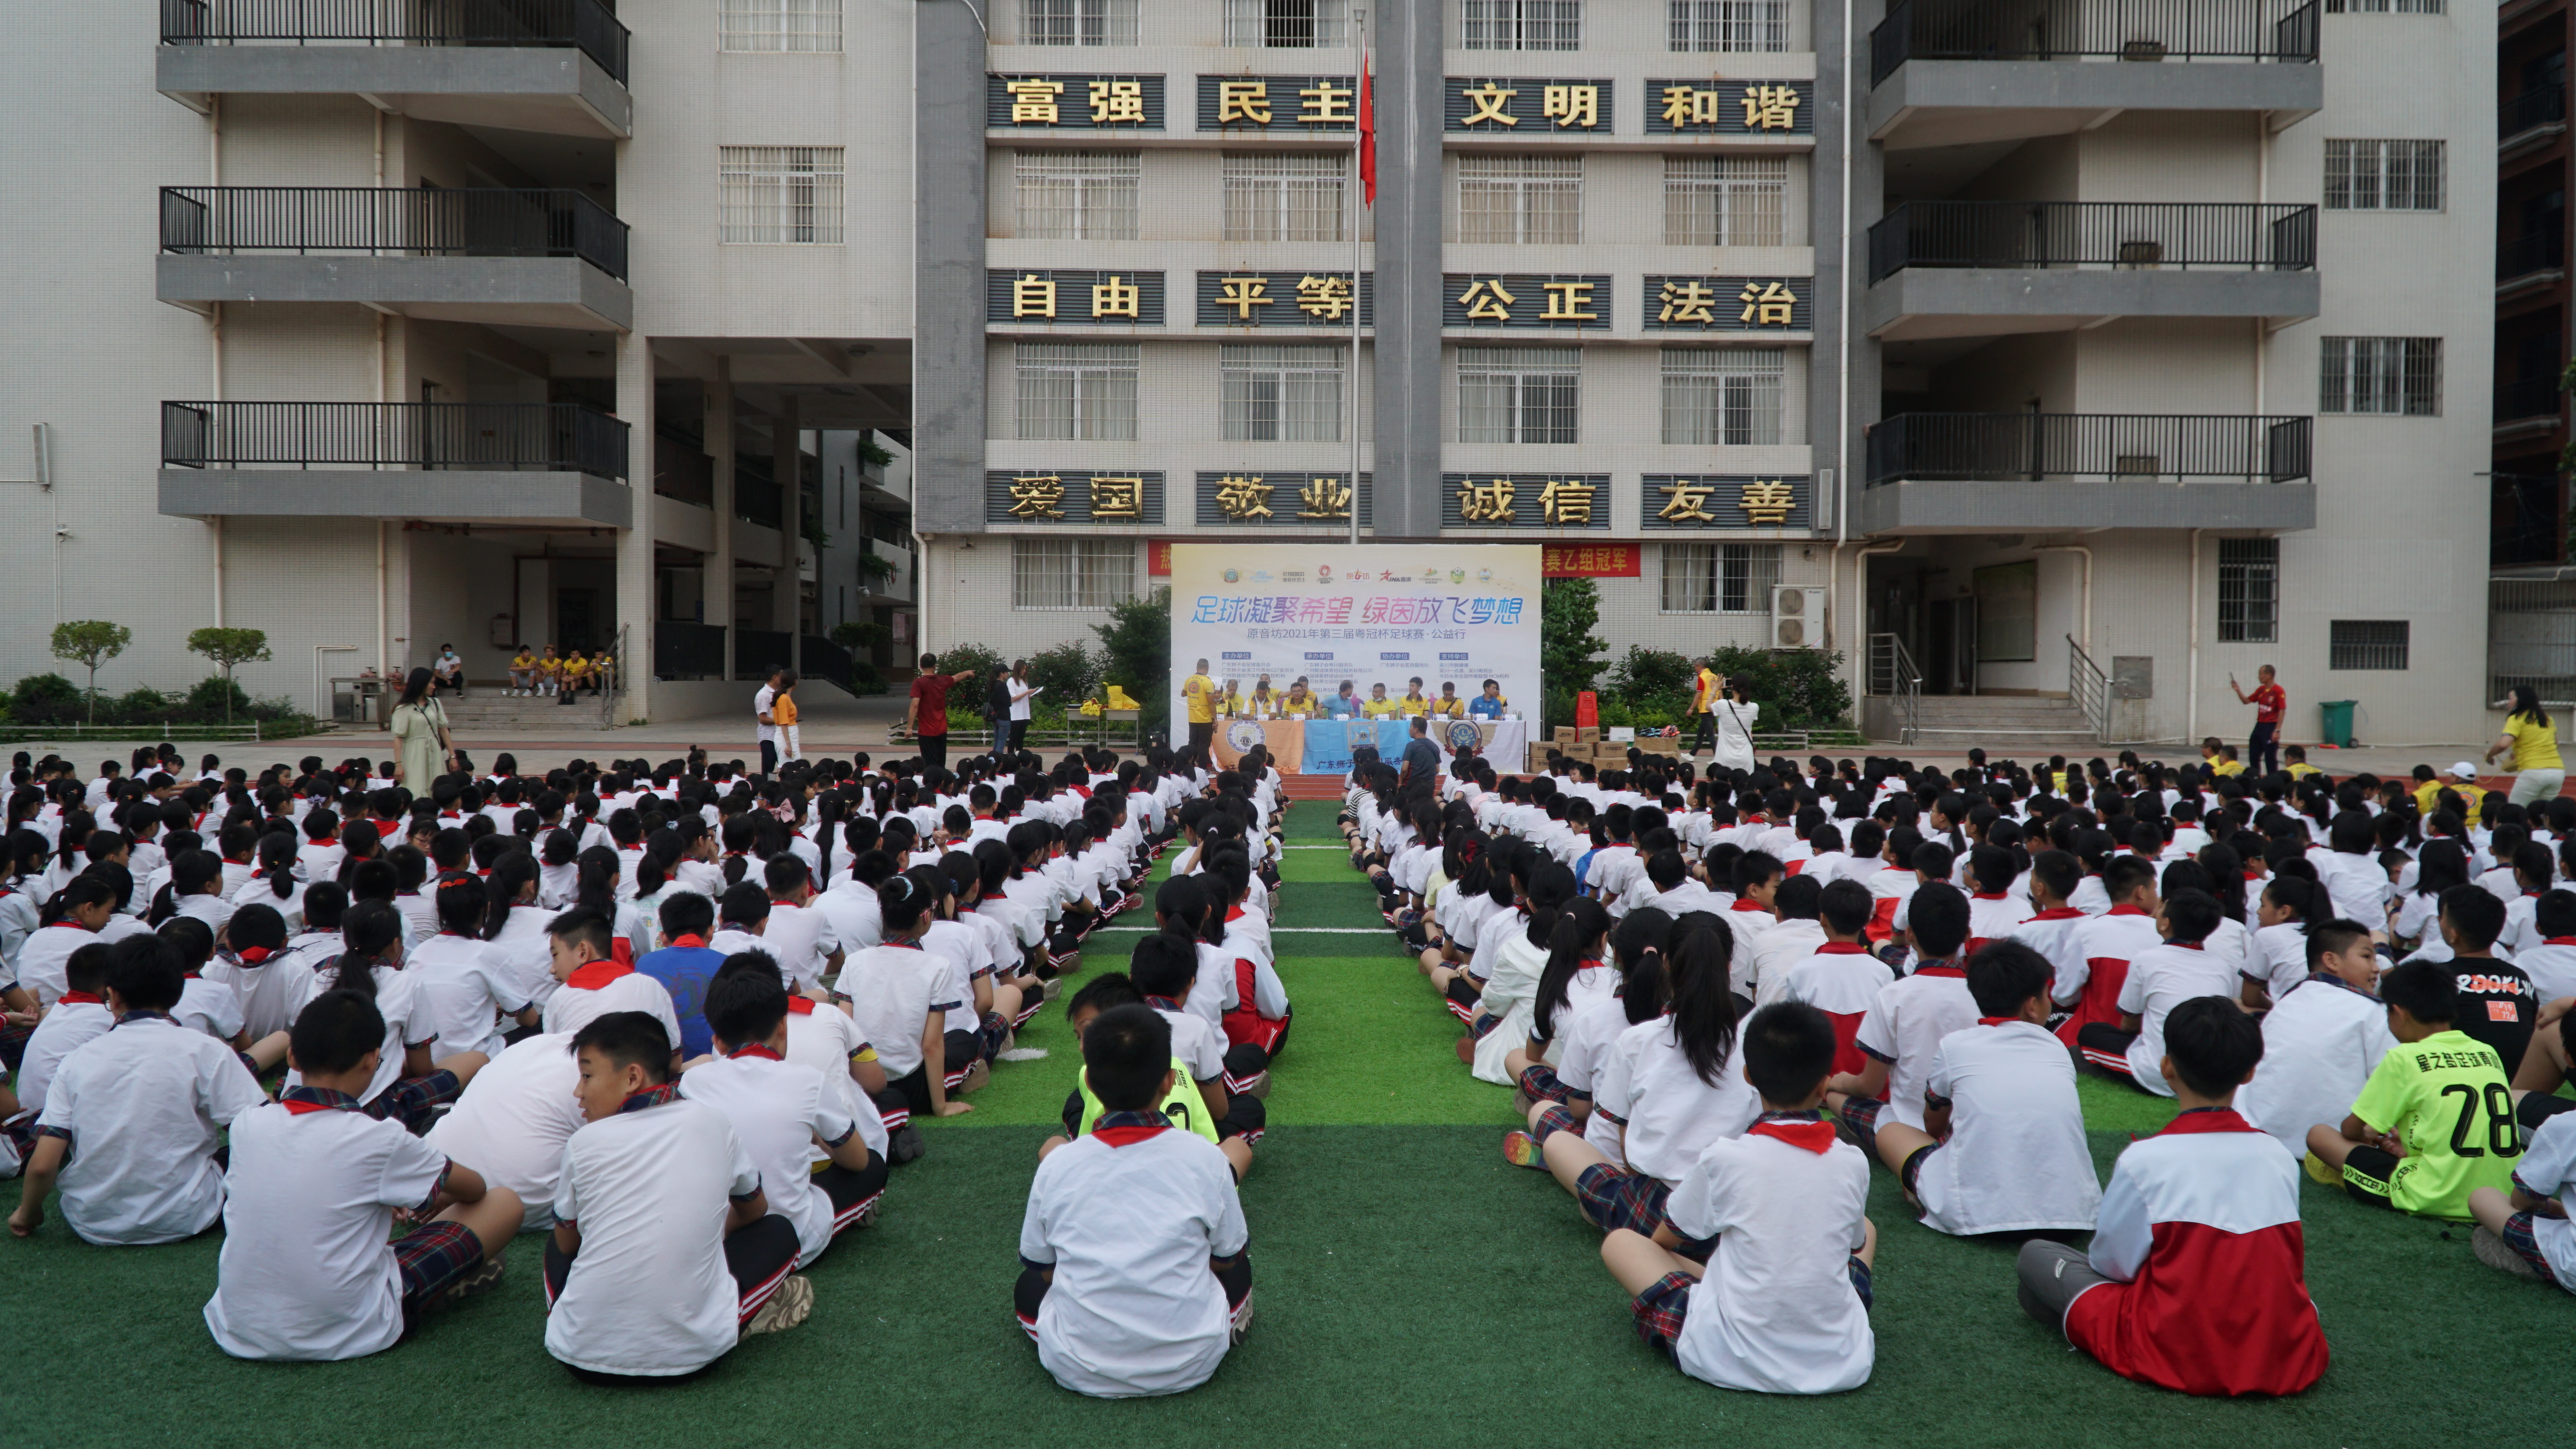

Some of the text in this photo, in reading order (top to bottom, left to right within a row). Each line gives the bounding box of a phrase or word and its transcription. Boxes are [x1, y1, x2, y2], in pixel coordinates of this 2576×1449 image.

[1007, 79, 1146, 124] 富强
[1218, 82, 1355, 124] 民主
[1461, 82, 1598, 127] 文明
[1662, 85, 1801, 130] 和谐
[1014, 274, 1139, 318] 自由
[1215, 276, 1353, 320] 平等
[1458, 279, 1597, 320] 公正
[1658, 281, 1798, 324] 法治
[1008, 476, 1142, 518] 爱国
[1215, 476, 1351, 519] 敬业
[1456, 479, 1596, 523] 诚信
[1658, 480, 1796, 523] 友善
[1542, 548, 1627, 572] 赛乙组冠军
[1191, 596, 1523, 624] 足球凝聚希望 绿茵放飞梦想
[2456, 974, 2534, 1000] ROOKLYN
[2441, 1083, 2521, 1157] 28
[2354, 1173, 2380, 1191] SOCCER
